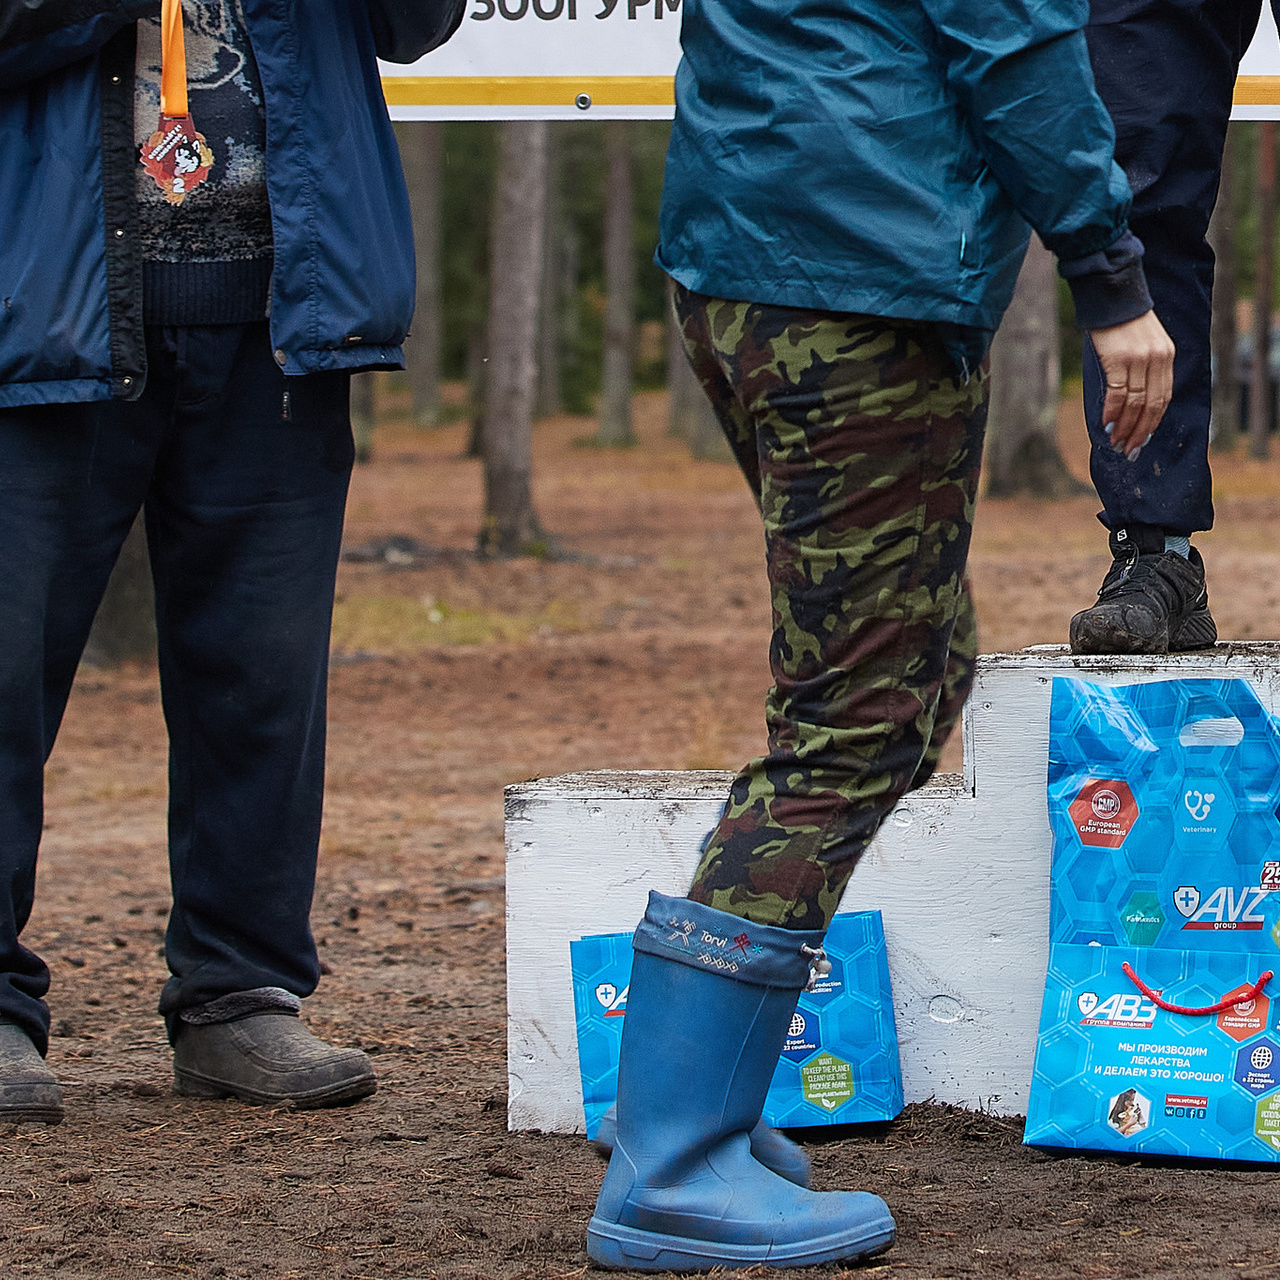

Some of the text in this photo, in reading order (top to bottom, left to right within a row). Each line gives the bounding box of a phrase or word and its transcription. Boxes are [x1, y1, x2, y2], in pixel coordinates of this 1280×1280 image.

[173, 178, 185, 193] 2
[1080, 825, 1126, 836] GMP standard
[1088, 820, 1120, 830] European
[1182, 826, 1217, 834] Veterinary
[1190, 886, 1271, 922] AVZ
[1214, 922, 1237, 930] group
[701, 930, 728, 948] Torvi
[1088, 994, 1157, 1022] АВЗ
[1086, 1019, 1110, 1027] группа
[1118, 1043, 1207, 1057] МЫ ПРОИЗВОДИМ
[1130, 1055, 1190, 1068] ЛЕКАРСТВА
[1094, 1066, 1225, 1083] И ДЕЛАЕМ ЭТО ХОРОШО!
